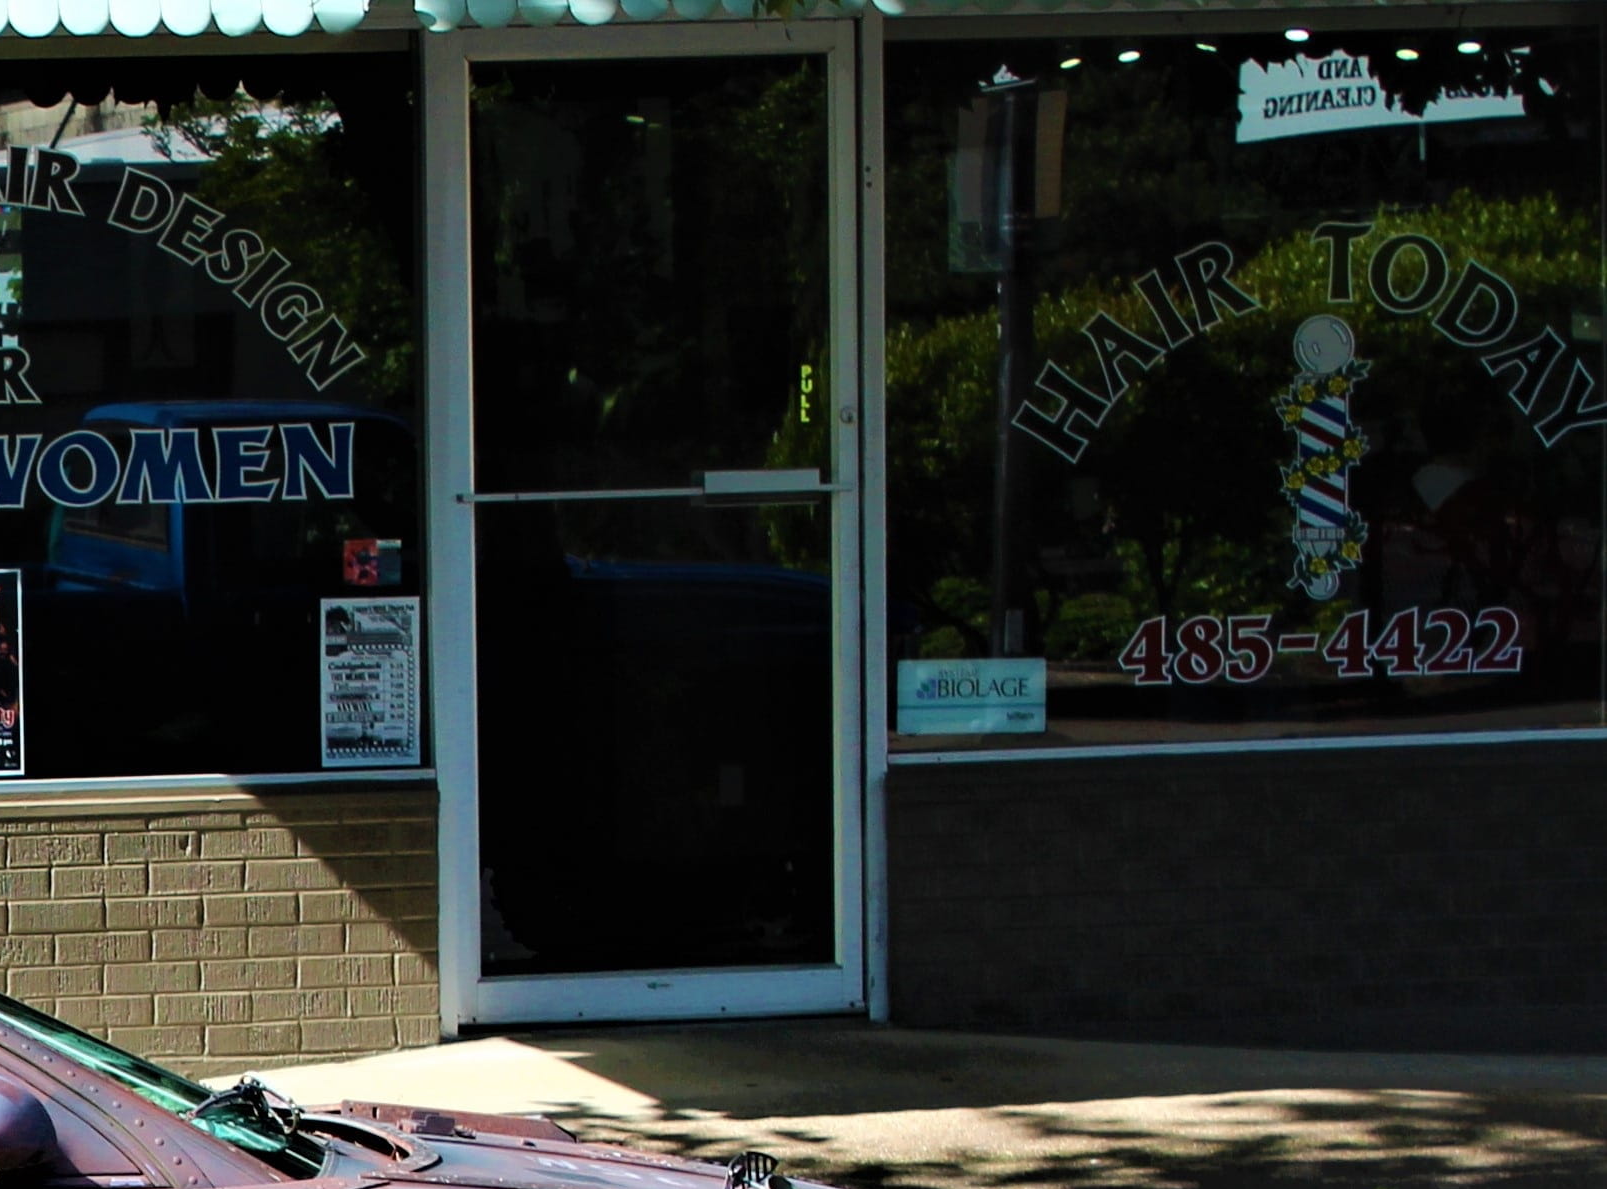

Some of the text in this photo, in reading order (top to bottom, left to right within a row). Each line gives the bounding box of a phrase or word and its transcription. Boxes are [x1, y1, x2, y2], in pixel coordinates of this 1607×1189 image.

[108, 166, 367, 393] DESIGN
[1011, 222, 1607, 463] HAIR TODAY
[938, 678, 1030, 698] BIOLAGE
[1119, 605, 1523, 686] 485-4422
